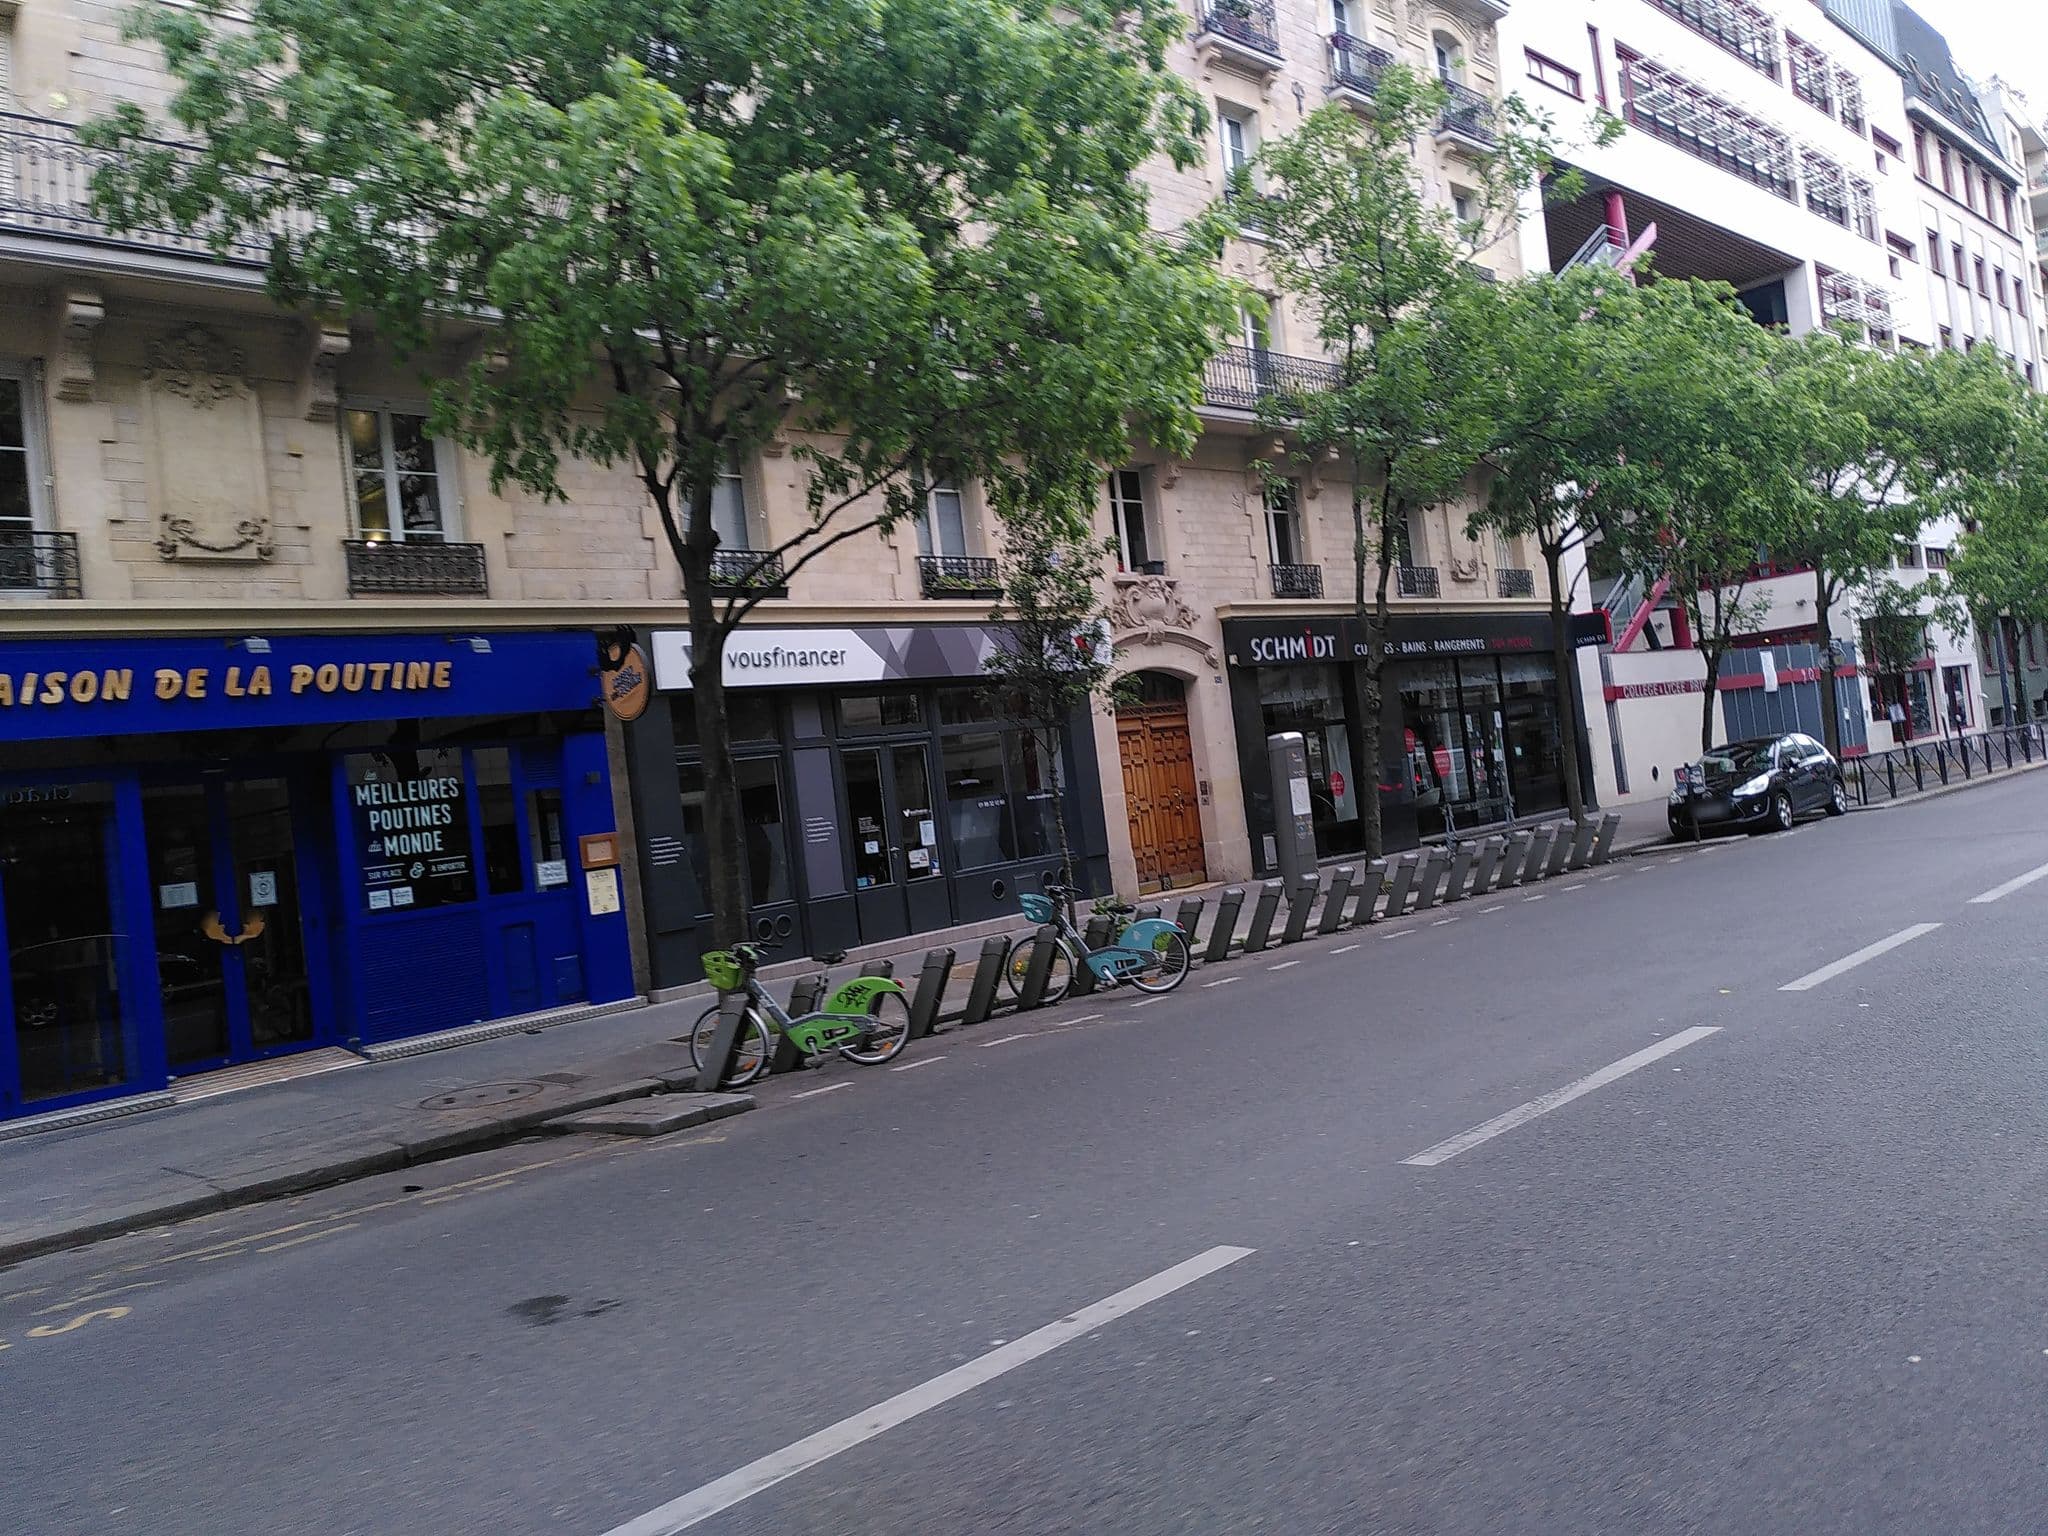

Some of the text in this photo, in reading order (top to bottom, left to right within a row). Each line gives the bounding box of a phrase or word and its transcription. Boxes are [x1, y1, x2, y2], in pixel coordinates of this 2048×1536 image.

[727, 646, 846, 669] vousfinancer
[1402, 641, 1427, 653] BAINS
[1433, 638, 1486, 652] RANGEMENTS
[154, 668, 209, 699] DE
[224, 665, 272, 697] LA
[289, 661, 452, 694] POUTINE
[355, 777, 459, 806] MEILLEURES
[369, 804, 452, 831] POUTINES
[384, 830, 444, 857] MONDE
